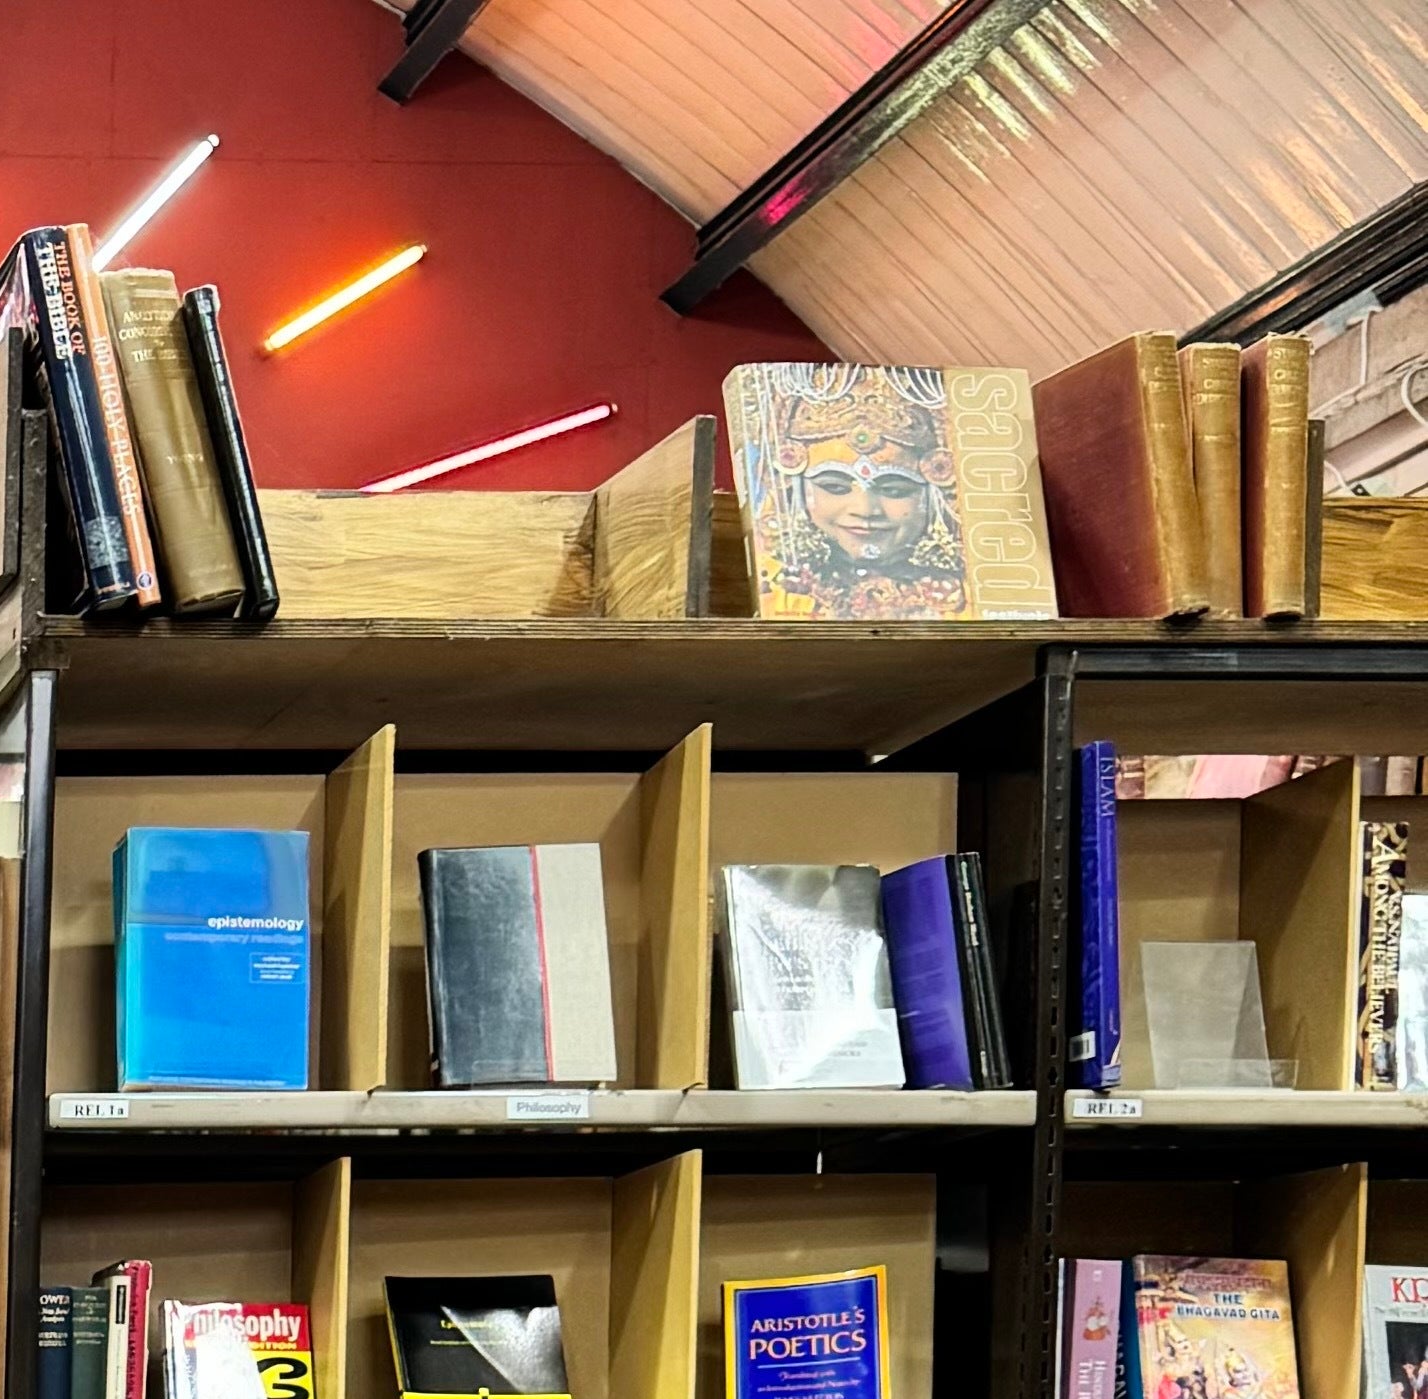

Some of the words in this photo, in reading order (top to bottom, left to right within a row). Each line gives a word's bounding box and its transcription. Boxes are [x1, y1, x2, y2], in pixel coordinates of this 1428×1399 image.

[208, 916, 303, 931] epistemology
[516, 1102, 581, 1117] Philosophy
[1214, 1292, 1243, 1307] THE
[749, 1330, 866, 1359] POETICS
